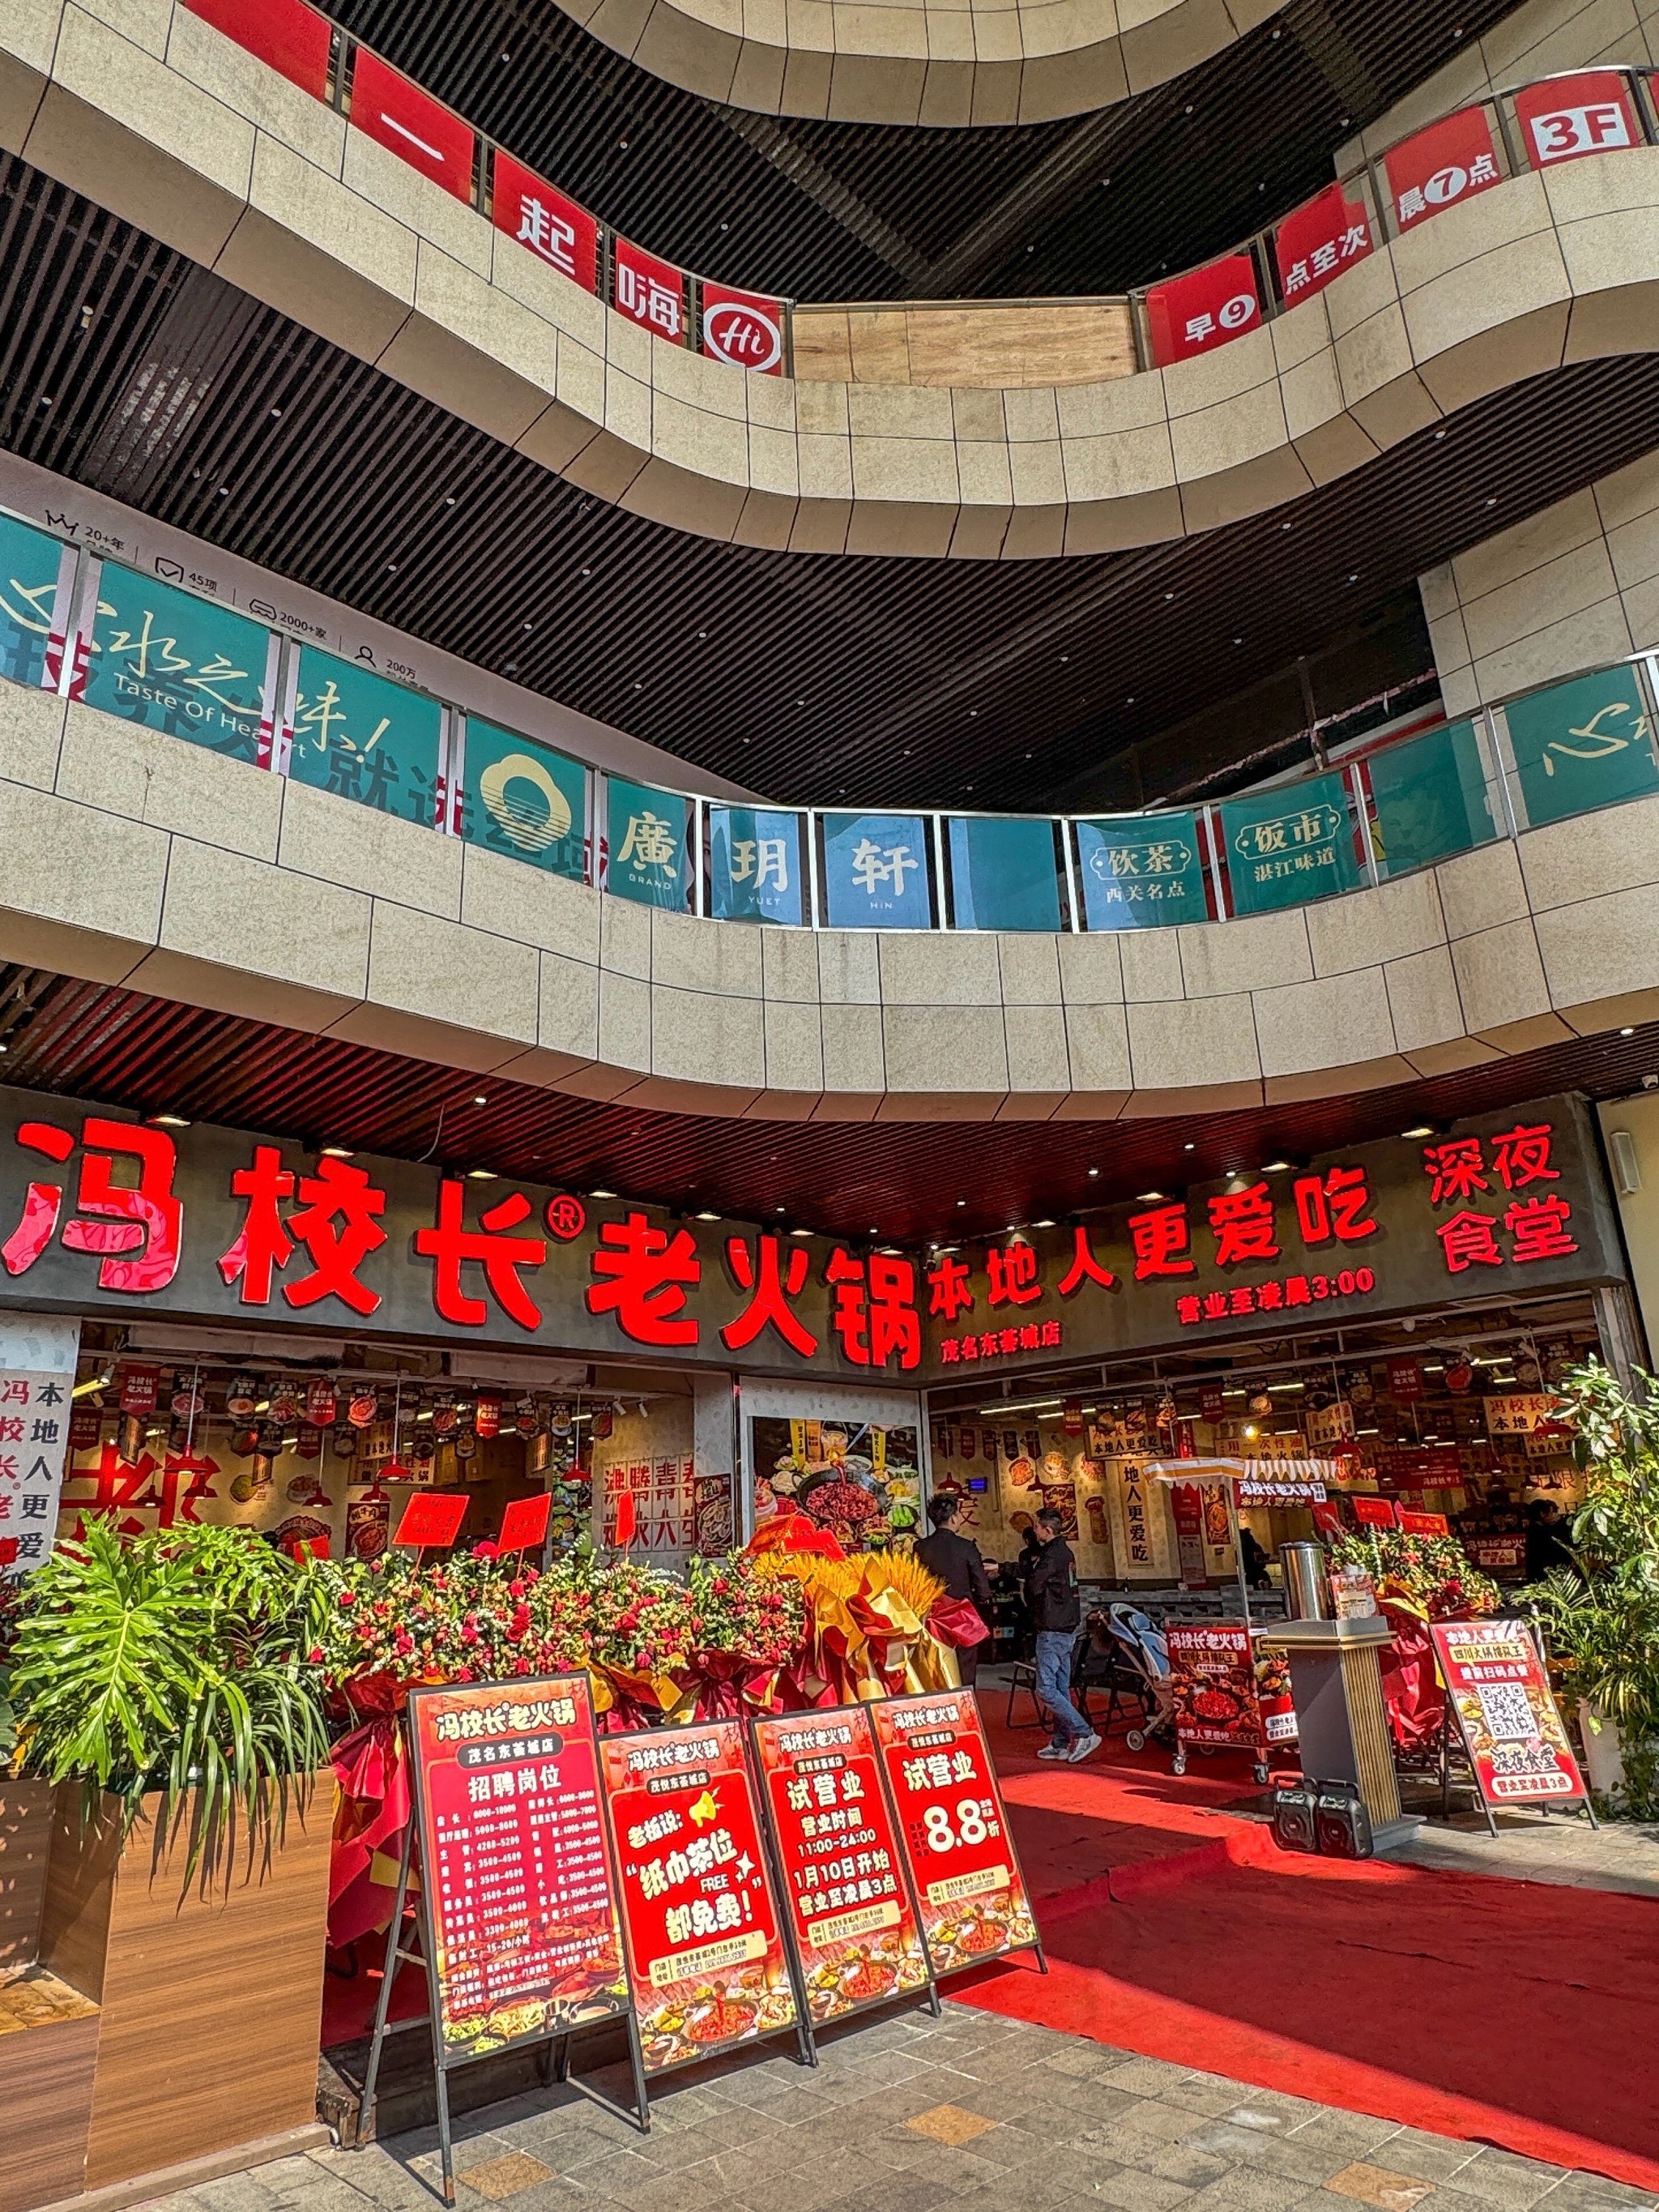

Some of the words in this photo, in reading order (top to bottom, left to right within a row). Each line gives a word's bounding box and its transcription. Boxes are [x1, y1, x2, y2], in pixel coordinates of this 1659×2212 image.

[1541, 106, 1618, 152] 3F
[1285, 223, 1367, 296] 点至次
[719, 316, 765, 355] Hi
[84, 526, 125, 551] 20+年
[189, 572, 218, 592] 45项
[279, 612, 327, 639] 2000+家
[386, 659, 416, 680] 200万
[113, 671, 177, 711] Taste
[185, 701, 215, 722] Of
[616, 811, 677, 878] 廣
[1254, 813, 1322, 853] 饭市
[851, 838, 919, 897] 轩
[1107, 845, 1174, 876] 饮茶
[1254, 847, 1337, 882] 湛江味道
[748, 896, 781, 907] YUET
[869, 900, 892, 910] HIN
[1106, 880, 1186, 903] 西关名点
[1423, 1124, 1561, 1205] 深夜
[928, 1167, 1378, 1321] 本地人更爱吃
[1435, 1194, 1579, 1274] 食堂
[1176, 1266, 1375, 1325] 营业至凌晨3:00
[1123, 1459, 1149, 1562] 地人更爱吃
[1461, 1664, 1529, 1680] 提前扫码点餐
[467, 1738, 554, 1765] 茂名东荟城店
[902, 1750, 978, 1791] 试营业
[1491, 1745, 1559, 1772] 深夜食堂
[467, 1764, 562, 1803] 招聘岗位
[786, 1770, 865, 1812] 试营业
[1496, 1776, 1569, 1793] 营业至凌晨3点
[801, 1806, 864, 1838] 营业时间
[923, 1798, 987, 1853] 8.8
[797, 1828, 877, 1858] 11:00-24:00
[699, 1873, 730, 1894] FREE
[793, 1847, 891, 1890] 1月10日开始
[798, 1873, 898, 1918] 营业至凌晨3点
